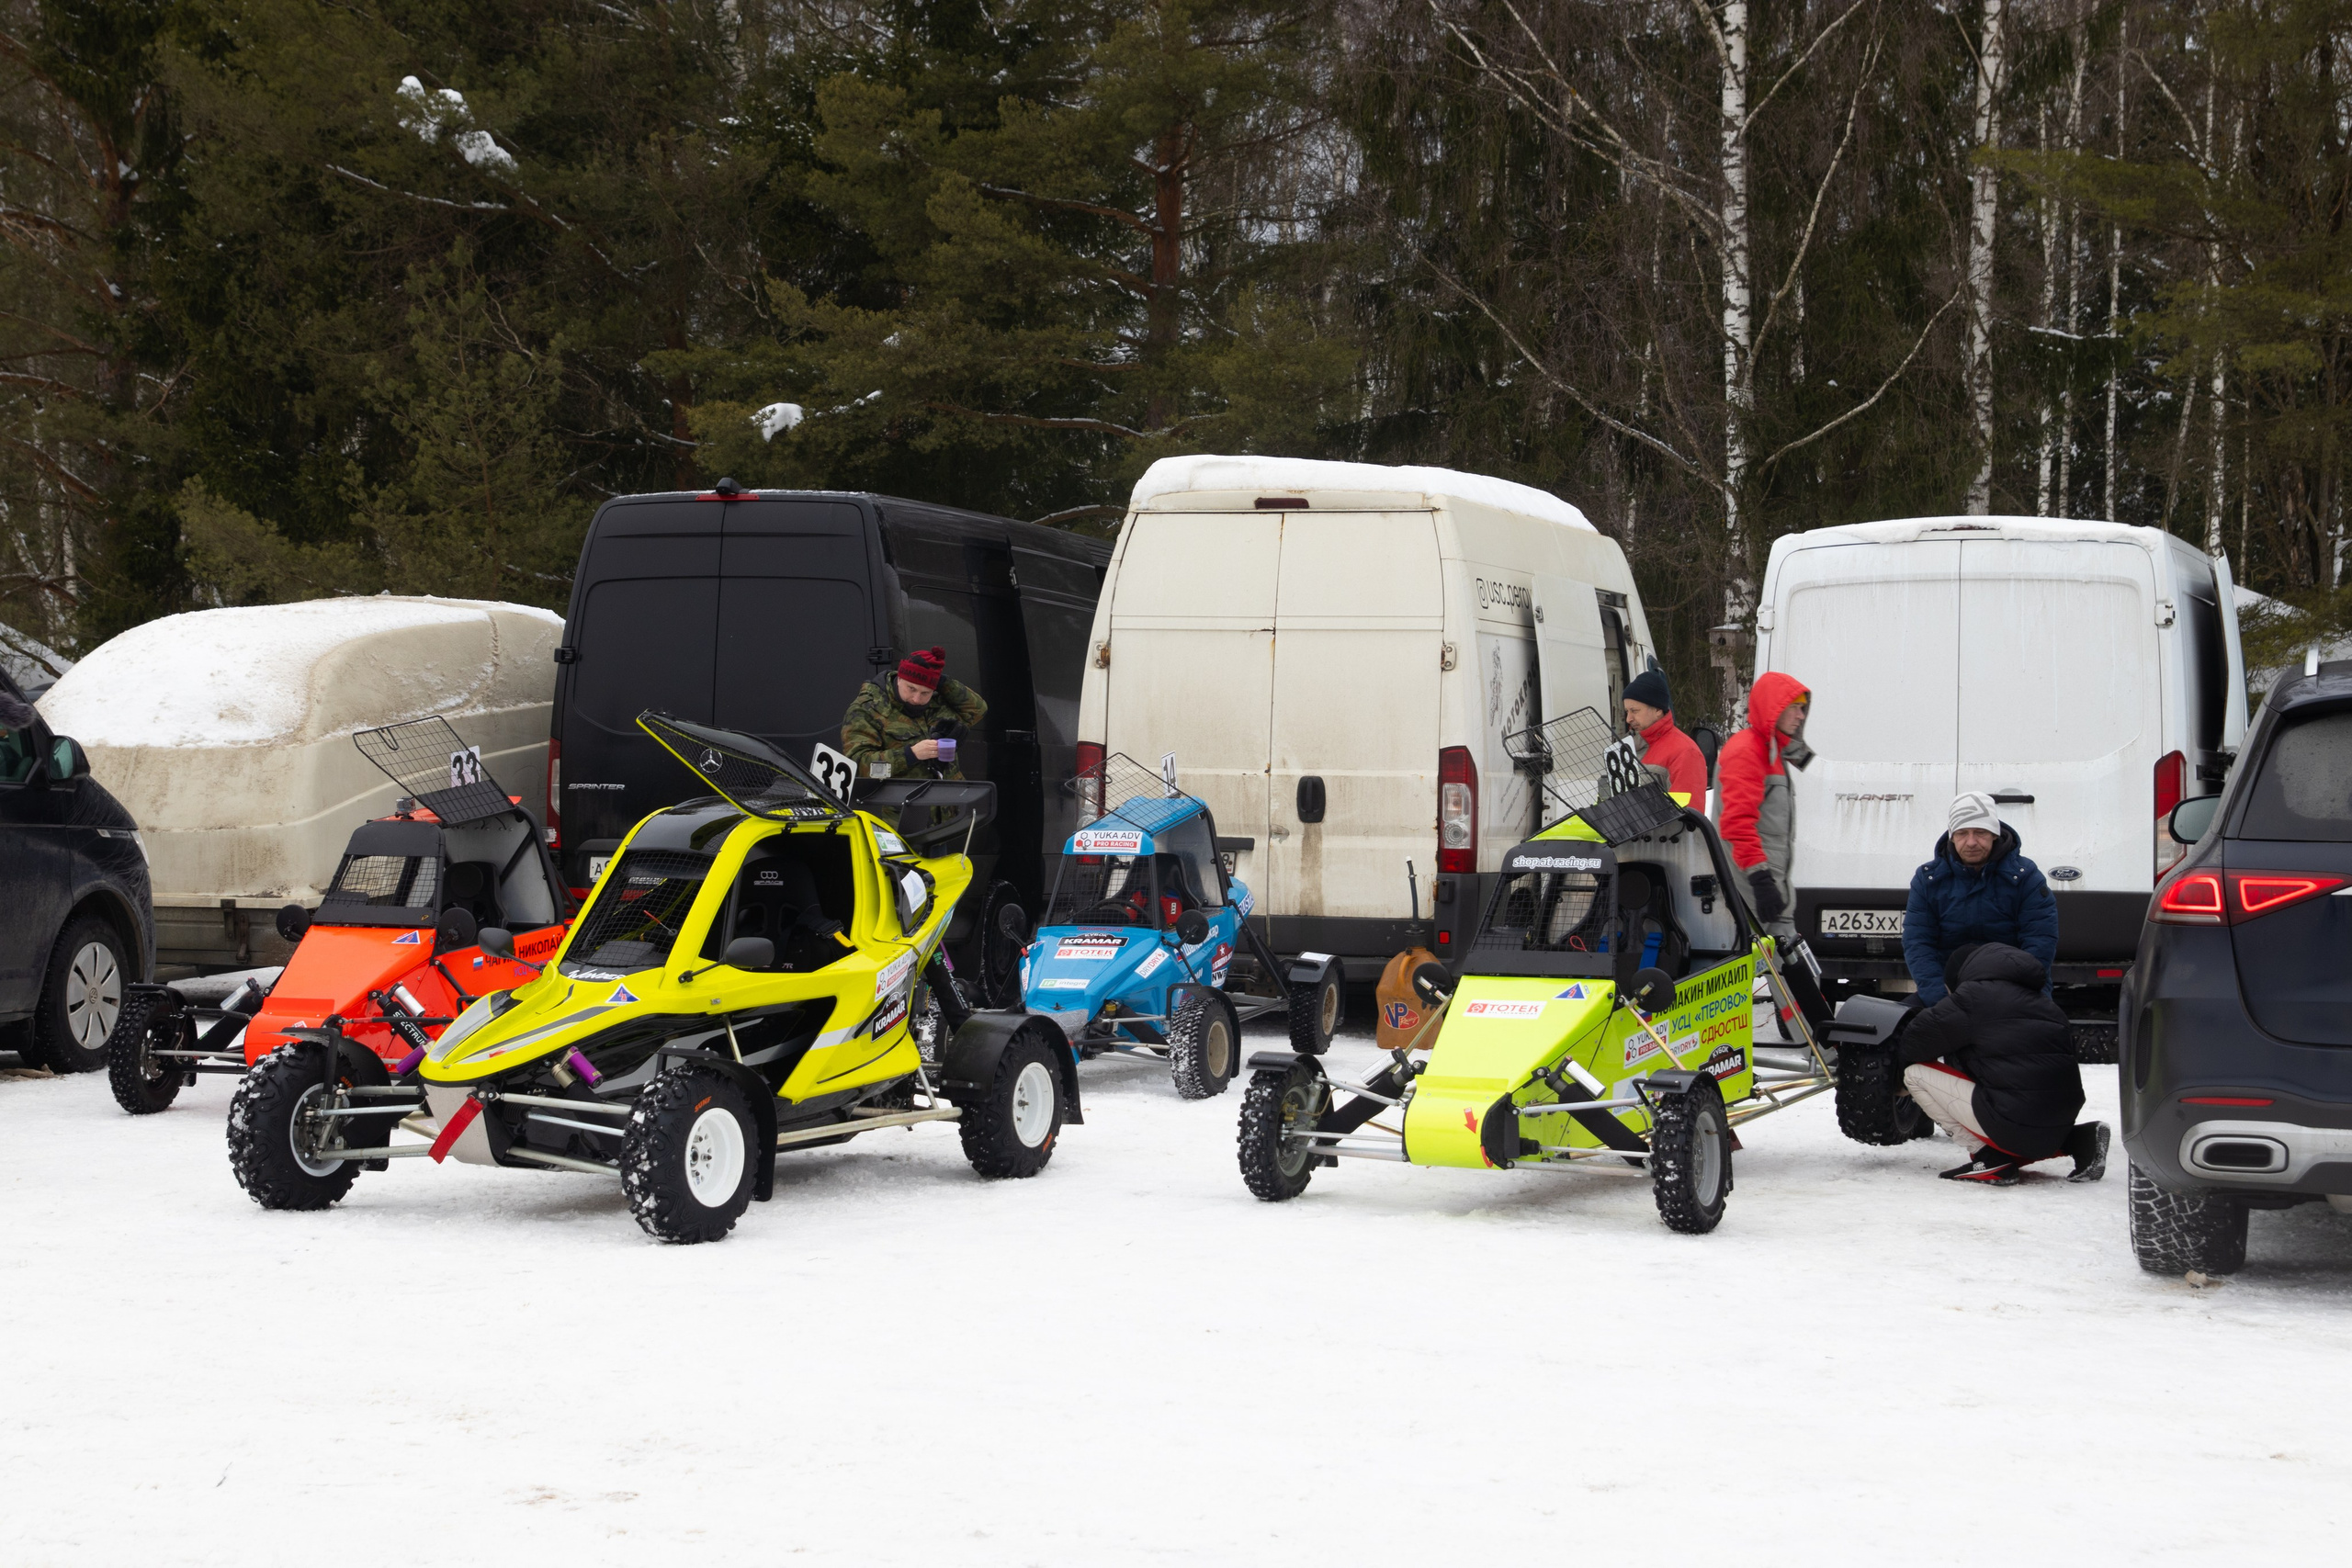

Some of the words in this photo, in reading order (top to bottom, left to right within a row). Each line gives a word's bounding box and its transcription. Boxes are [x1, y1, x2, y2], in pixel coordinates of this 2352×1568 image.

[453, 751, 481, 786] 33
[817, 751, 853, 806] 33
[1163, 756, 1177, 794] 14
[1607, 743, 1640, 797] 88
[568, 783, 626, 791] SPRINTER
[1834, 793, 1914, 802] TRANSIT
[1093, 831, 1119, 840] YUKA
[1120, 831, 1141, 840] ADV
[1512, 855, 1602, 871] shop.at-racing.ru
[519, 933, 562, 959] НИКОЛАЙ
[1058, 979, 1087, 987] integra
[1705, 964, 1748, 994] МИХАИЛ
[875, 999, 906, 1033] KRAMAR
[1385, 1002, 1408, 1029] VP
[1489, 1004, 1540, 1013] TOTEK
[1671, 1012, 1691, 1034] УСЦ
[1694, 992, 1748, 1022] «ПЕРОВО»
[1701, 1013, 1748, 1044] СДЮСТШ
[1713, 1045, 1729, 1058] КУБОК
